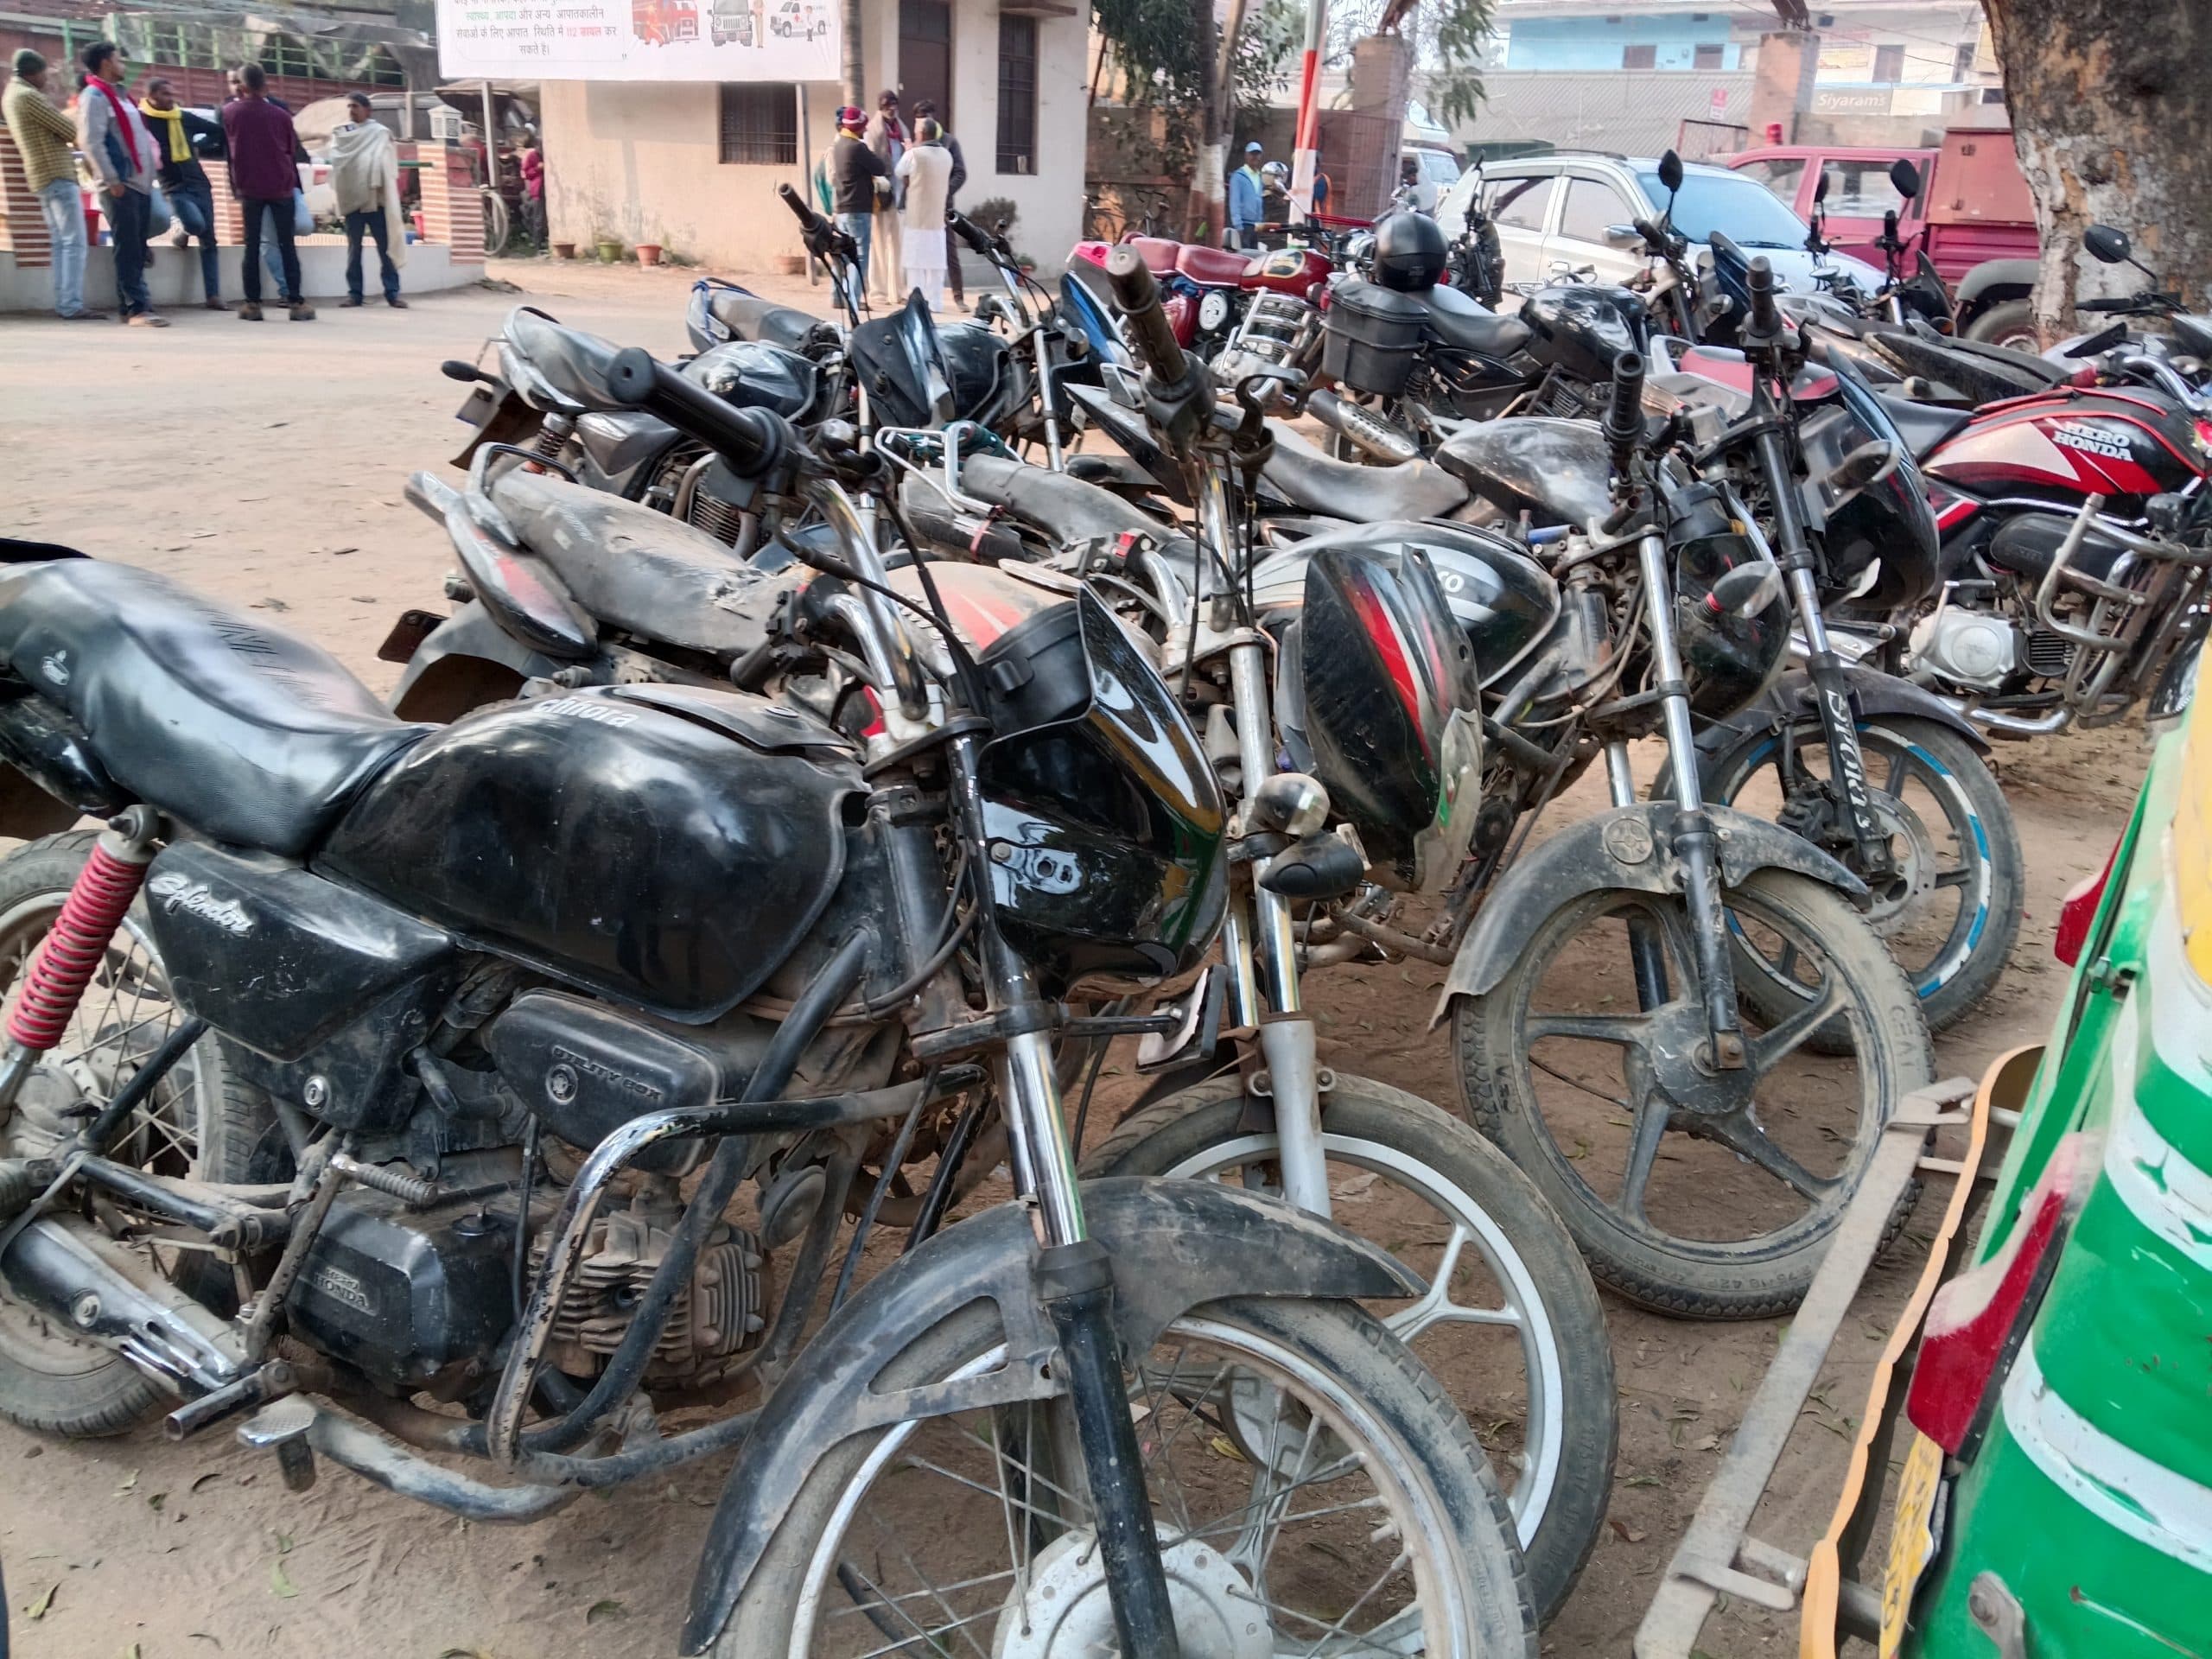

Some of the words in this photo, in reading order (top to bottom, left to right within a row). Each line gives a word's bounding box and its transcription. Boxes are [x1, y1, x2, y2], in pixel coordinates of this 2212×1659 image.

[518, 8, 532, 20] और
[535, 10, 550, 20] अन्य
[556, 5, 604, 20] आपातकालीन
[490, 25, 504, 40] लिए
[506, 28, 529, 38] आपात
[566, 27, 577, 36] 112
[604, 27, 617, 36] कर
[518, 41, 539, 55] सकते
[2052, 430, 2134, 461] HONDA
[2064, 420, 2131, 448] HERO
[551, 1045, 623, 1082] UTILITY
[622, 1078, 663, 1100] BOX
[314, 1272, 370, 1308] HONDA
